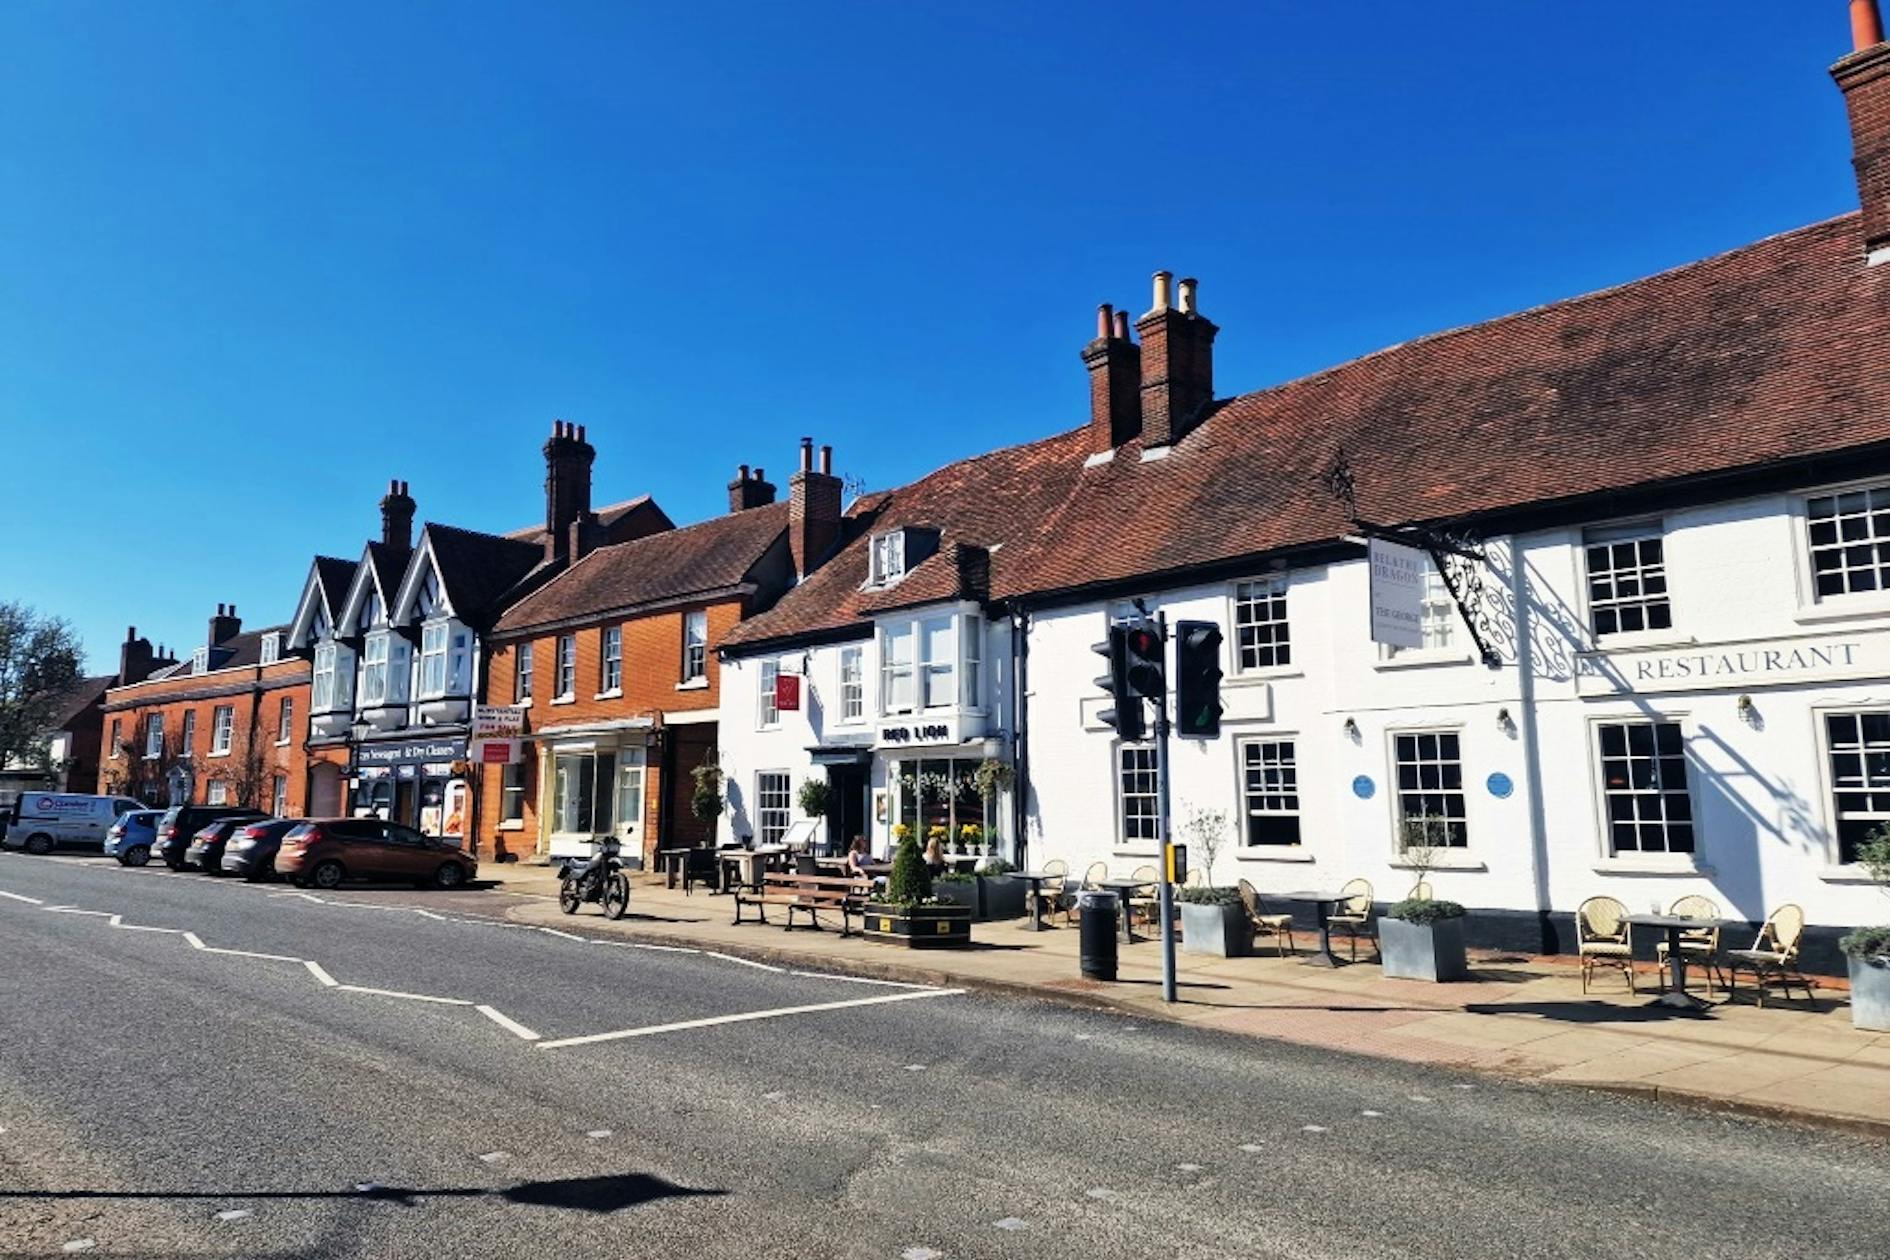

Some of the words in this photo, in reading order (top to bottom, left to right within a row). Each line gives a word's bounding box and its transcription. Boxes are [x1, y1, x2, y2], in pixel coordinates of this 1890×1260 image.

[1637, 643, 1861, 680] RESTAURANT
[882, 728, 909, 742] RED
[914, 725, 949, 742] LION
